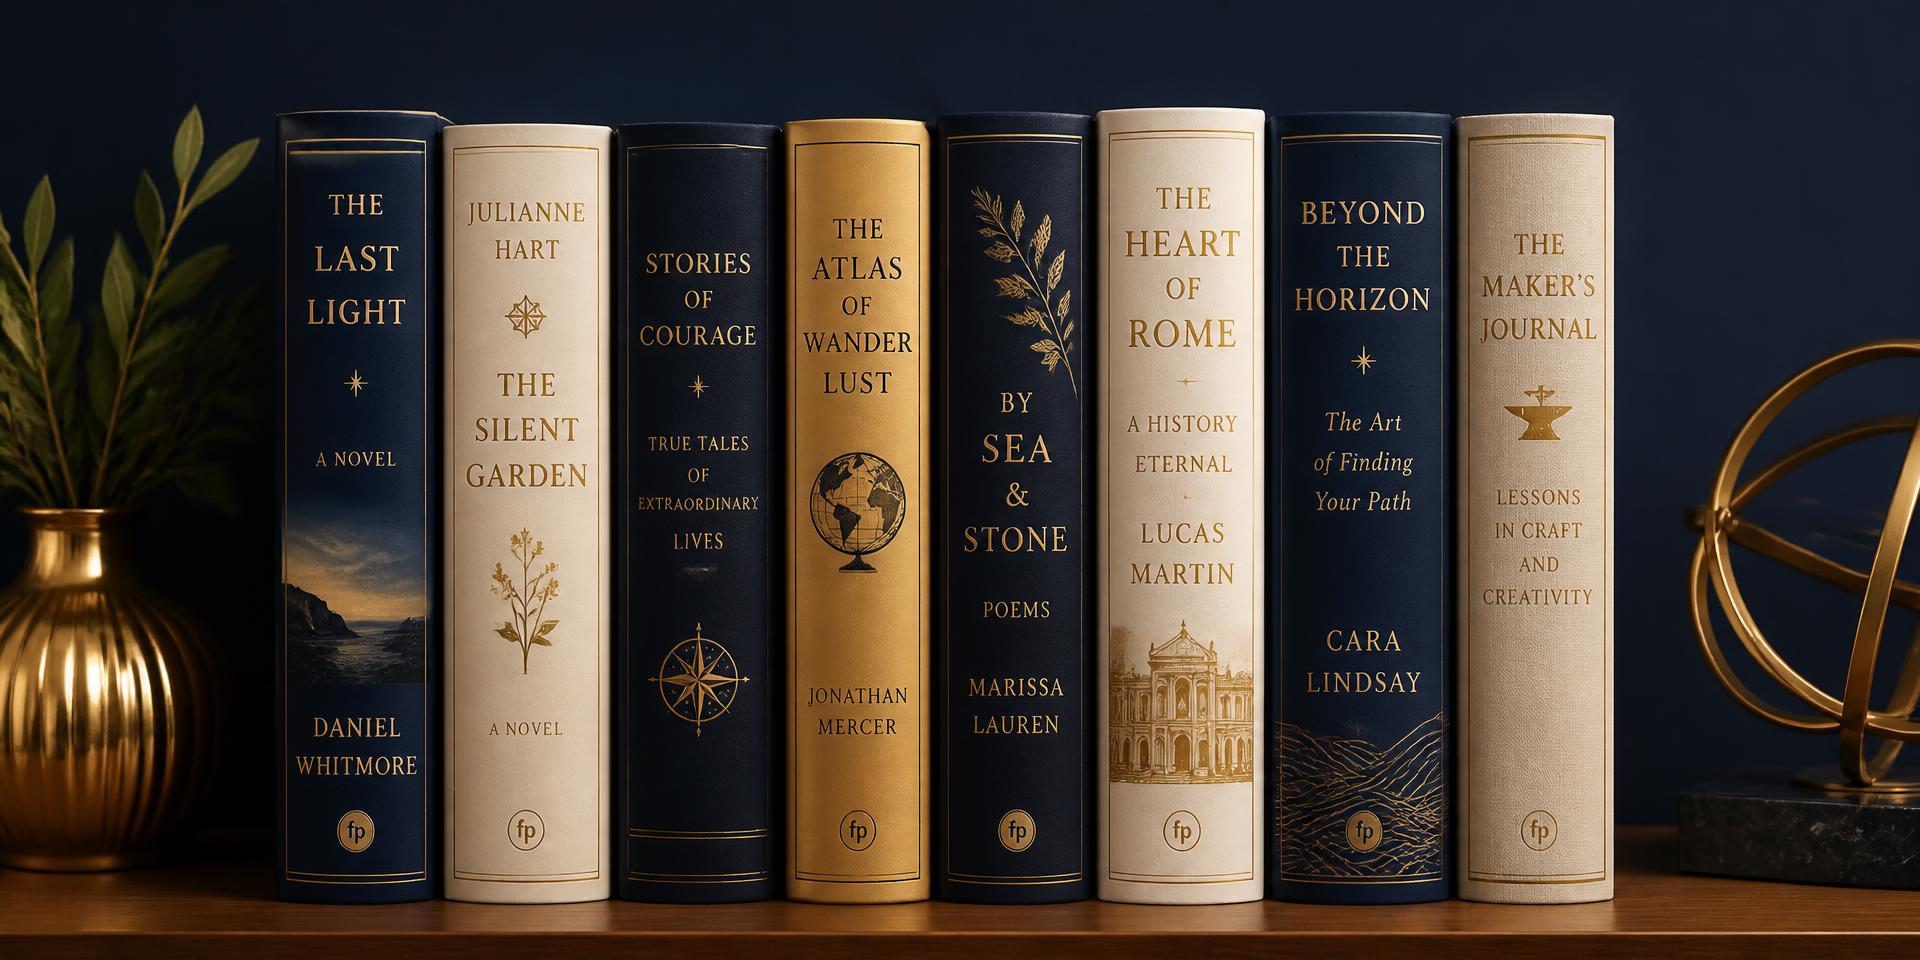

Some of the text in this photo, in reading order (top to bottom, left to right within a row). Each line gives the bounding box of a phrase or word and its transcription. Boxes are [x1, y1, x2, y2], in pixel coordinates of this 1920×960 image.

[329, 194, 383, 215] THE
[1156, 187, 1210, 209] THE
[467, 202, 585, 226] JULIANNE
[1301, 201, 1424, 224] BEYOND
[833, 218, 886, 240] THE
[495, 240, 560, 259] HART
[1124, 229, 1240, 257] HEART
[1514, 234, 1565, 255] THE
[315, 245, 399, 271] LAST
[647, 253, 750, 274] STORIES
[1337, 246, 1389, 267] THE
[812, 256, 902, 280] ATLAS
[1166, 277, 1200, 299] OF
[685, 291, 712, 308] OF
[842, 296, 871, 316] OF
[1296, 288, 1430, 310] HORIZON
[308, 299, 406, 324] LIGHT
[641, 325, 756, 345] COURAGE
[1128, 319, 1236, 348] ROME
[1480, 318, 1597, 344] JOURNAL
[803, 332, 913, 353] WANDER
[497, 373, 555, 396] THE
[823, 371, 892, 395] LUST
[1001, 392, 1032, 413] BY
[476, 417, 578, 441] SILENT
[1127, 416, 1237, 433] A HISTORY
[1326, 411, 1401, 431] The Art
[649, 436, 748, 451] TRUE TALES
[983, 434, 1052, 462] SEA
[316, 451, 396, 466] A NOVEL
[1135, 455, 1233, 473] ETERNAL
[1315, 451, 1413, 476] of Finding
[466, 463, 588, 488] GARDEN
[688, 467, 710, 483] OF
[638, 496, 759, 511] EXTRAORDINARY
[1006, 483, 1029, 506] &
[1316, 491, 1411, 510] Your Path
[1497, 489, 1580, 505] LESSONS
[675, 533, 723, 549] LIVES
[965, 526, 1067, 552] STONE
[1141, 523, 1224, 544] LUCAS
[1496, 522, 1583, 539] IN CRAFT
[1130, 563, 1235, 584] MARTIN
[1519, 555, 1559, 573] AND
[1482, 588, 1593, 606] CREATIVITY
[984, 601, 1049, 618] POEMS
[1327, 630, 1401, 651] CARA
[971, 678, 1063, 696] MARISSA
[1307, 672, 1420, 692] LINDSAY
[808, 687, 908, 707] JONATHAN
[314, 718, 400, 737] DANIEL
[489, 722, 562, 735] A NOVEL
[818, 718, 897, 736] MERCER
[975, 715, 1058, 733] LAUREN
[297, 756, 417, 775] WHITMORE
[346, 821, 366, 843] fp
[516, 821, 536, 843] fp
[849, 820, 868, 842] fp
[1008, 820, 1027, 842] fp
[1172, 820, 1191, 842] fp
[1355, 821, 1374, 844] fp
[1529, 820, 1549, 843] fp
